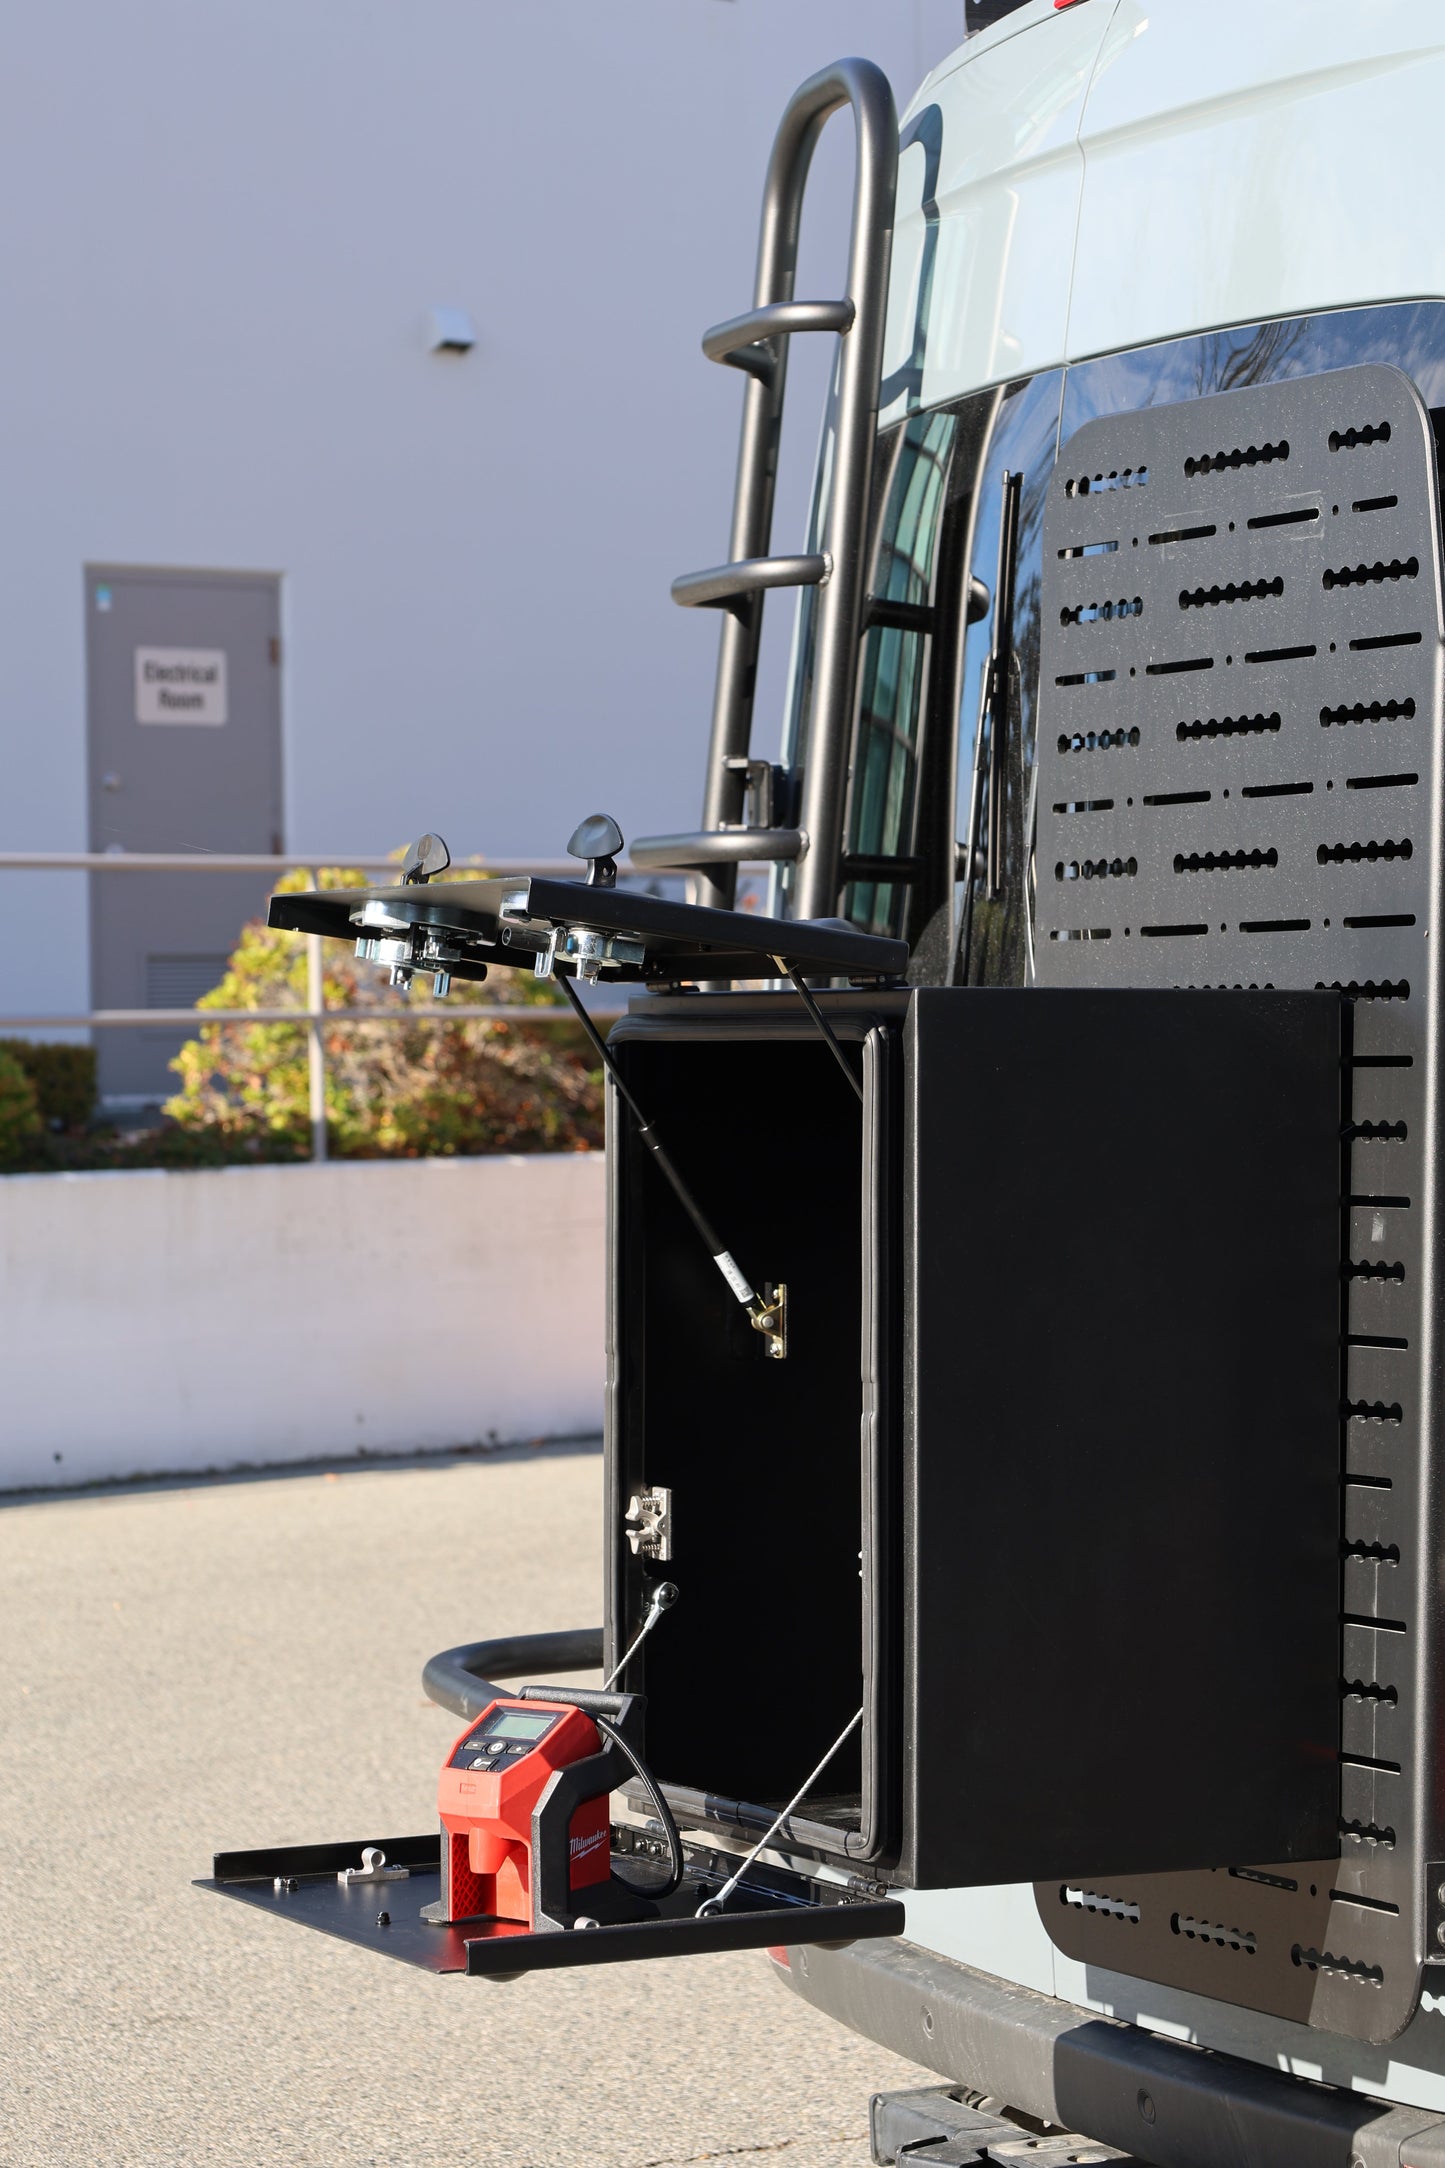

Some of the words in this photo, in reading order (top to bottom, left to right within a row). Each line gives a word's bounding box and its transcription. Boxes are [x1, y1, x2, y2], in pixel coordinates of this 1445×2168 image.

[143, 660, 218, 684] Electrical
[158, 688, 205, 710] Room
[569, 1830, 607, 1855] Milwaukee
